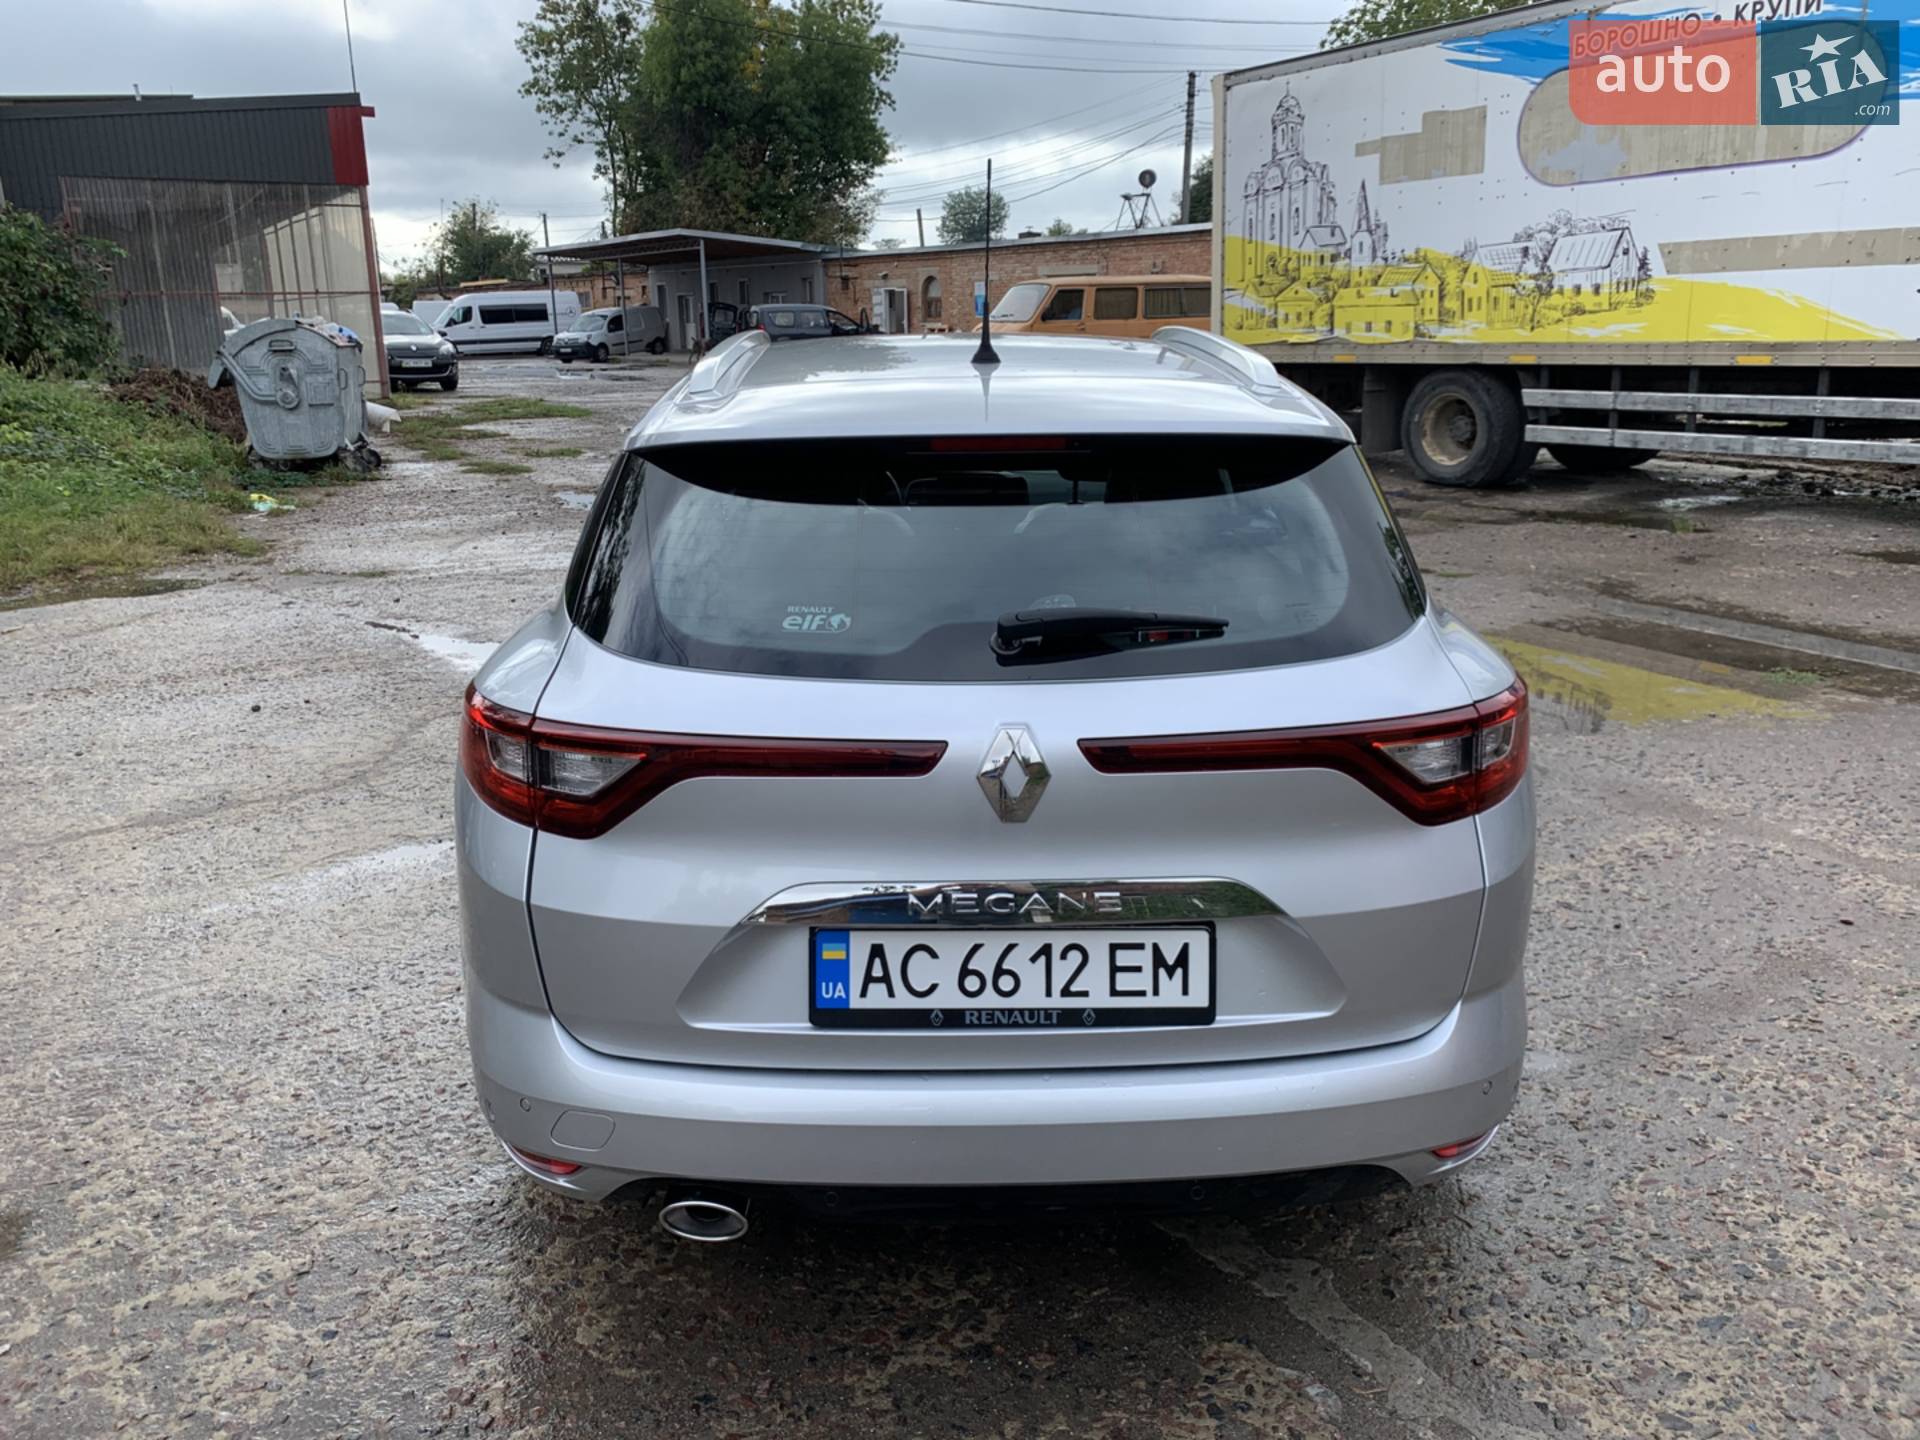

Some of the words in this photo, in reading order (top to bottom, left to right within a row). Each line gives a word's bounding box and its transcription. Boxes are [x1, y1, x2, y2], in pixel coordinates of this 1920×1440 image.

[1574, 12, 1702, 57] БОРОШНО
[1733, 0, 1822, 27] КРУПИ
[787, 605, 836, 614] RENAULT
[907, 891, 1123, 915] MEGANE
[859, 942, 940, 999] AC
[957, 942, 1090, 998] 6612
[1108, 941, 1190, 997] EM
[821, 981, 847, 999] UA
[964, 1009, 1063, 1025] RENAULT
